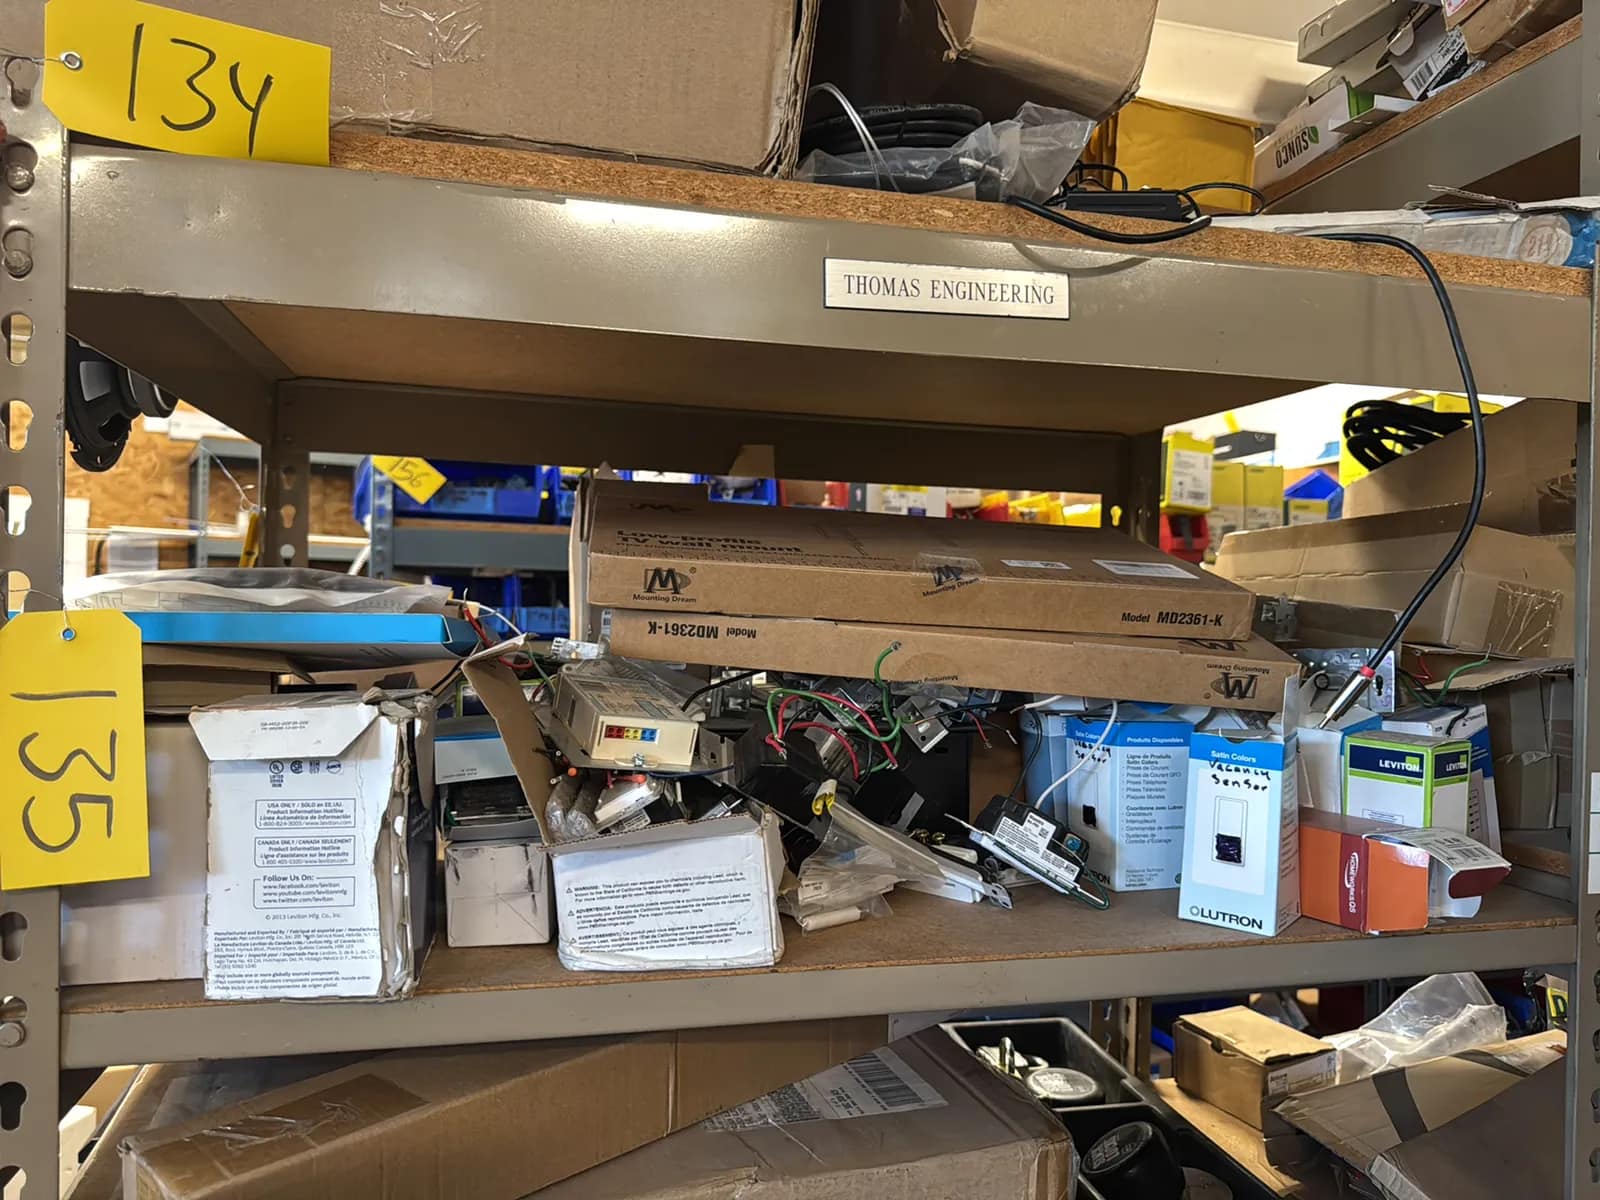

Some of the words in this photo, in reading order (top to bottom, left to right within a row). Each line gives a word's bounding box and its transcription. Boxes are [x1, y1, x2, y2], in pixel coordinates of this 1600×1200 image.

[127, 22, 274, 158] 134
[1275, 131, 1310, 169] SUNCO
[843, 274, 921, 297] THOMAS
[930, 280, 1055, 305] ENGINEERING
[389, 458, 431, 488] 156
[617, 530, 762, 544] Low-profile
[720, 544, 803, 552] mount
[922, 585, 956, 597] Mounting
[957, 577, 979, 588] Dream
[632, 594, 670, 602] Mounting
[672, 596, 697, 604] Dream
[1121, 612, 1151, 623] Model
[1157, 611, 1224, 627] MD2361-K
[648, 621, 719, 639] MD2361-K
[726, 627, 757, 639] Model
[1206, 662, 1232, 670] Dream
[1232, 664, 1270, 674] Mounting
[1210, 750, 1230, 760] Satin
[1231, 753, 1256, 763] Colors
[10, 690, 117, 853] 135
[1379, 759, 1420, 772] LEVITON
[1446, 762, 1467, 772] LEVITON
[1200, 907, 1263, 930] LUTRON
